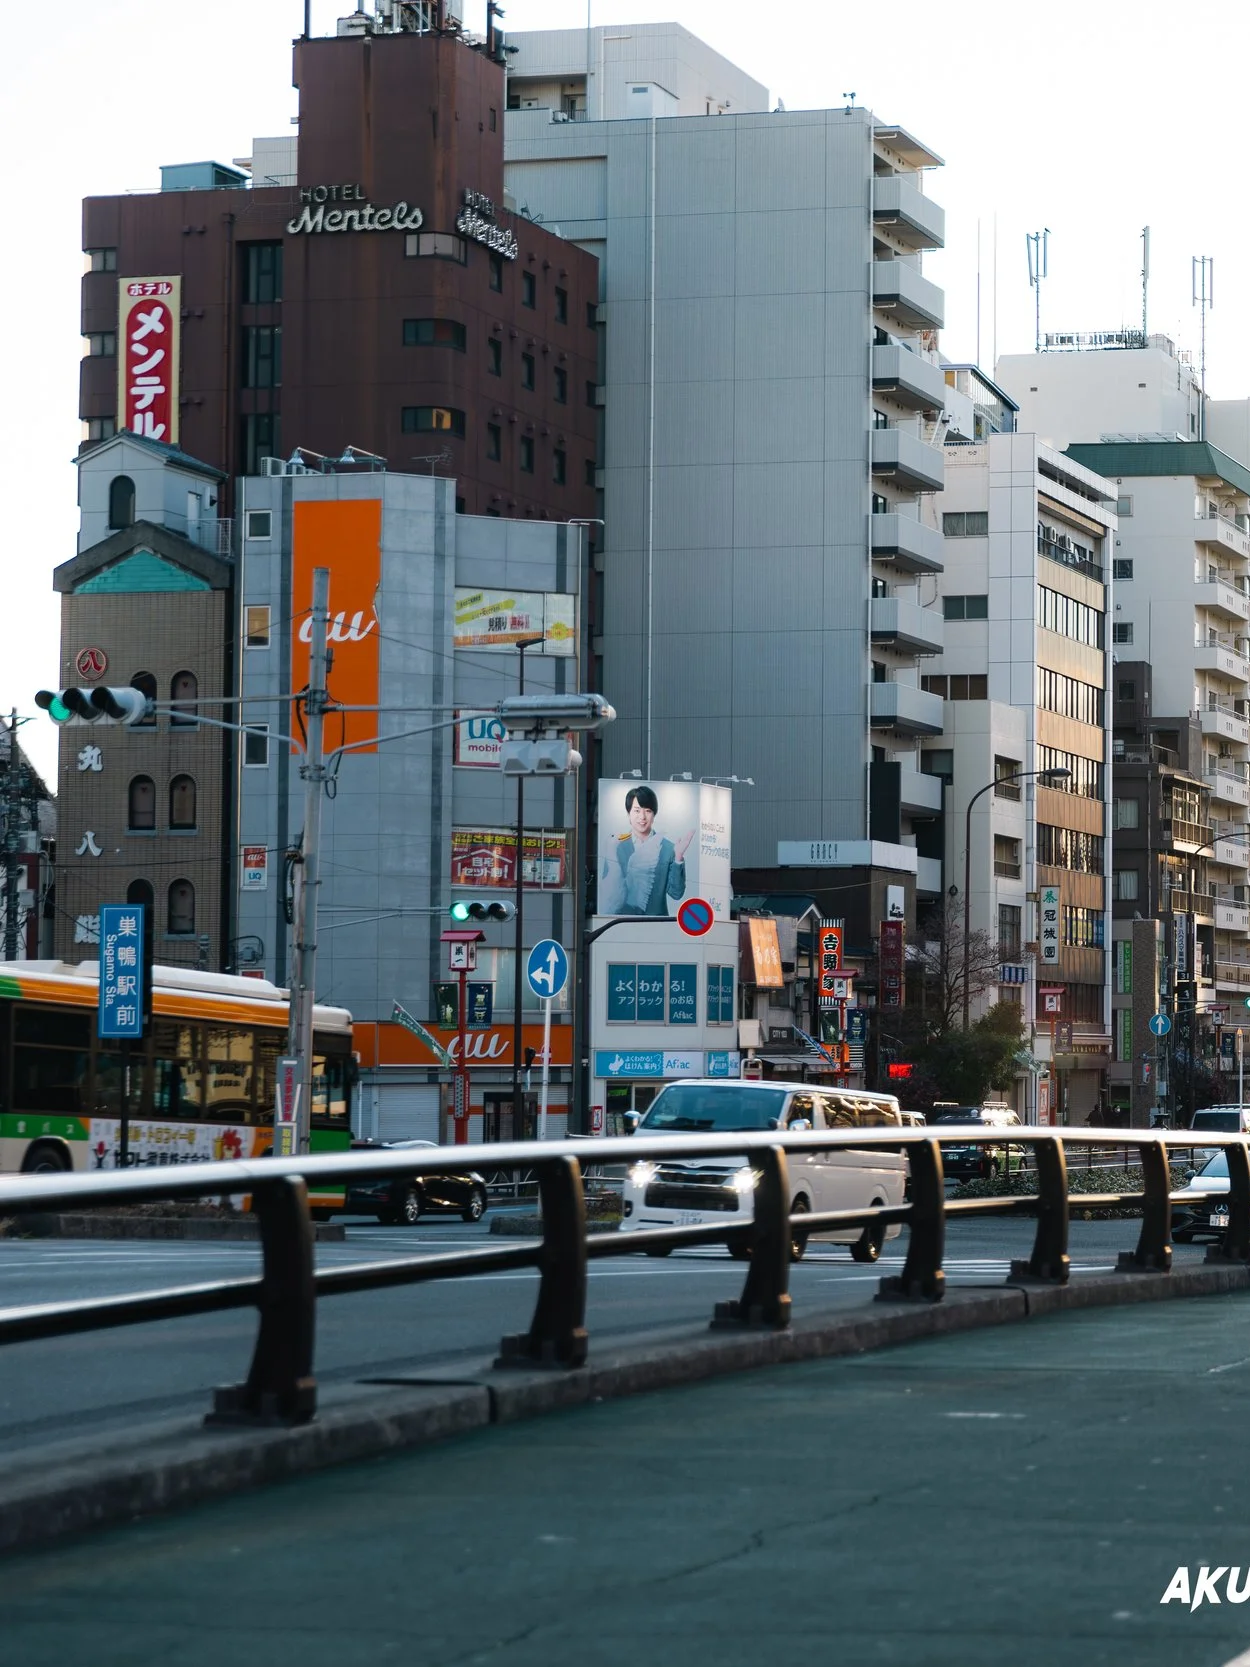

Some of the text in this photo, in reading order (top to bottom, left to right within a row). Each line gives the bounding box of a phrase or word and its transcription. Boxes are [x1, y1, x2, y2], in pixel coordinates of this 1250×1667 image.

[301, 184, 366, 202] HOTEL
[286, 201, 424, 234] Mentels
[130, 282, 171, 296] ホテル
[130, 306, 166, 441] メンテル
[468, 719, 507, 743] UQ
[468, 744, 502, 753] mobil
[104, 934, 118, 1008] Sugamo Sta.
[116, 915, 138, 1026] 巣鴨駅前
[615, 979, 686, 992] よくわかる!
[618, 995, 695, 1006] アフラックのお店
[447, 1033, 511, 1059] au
